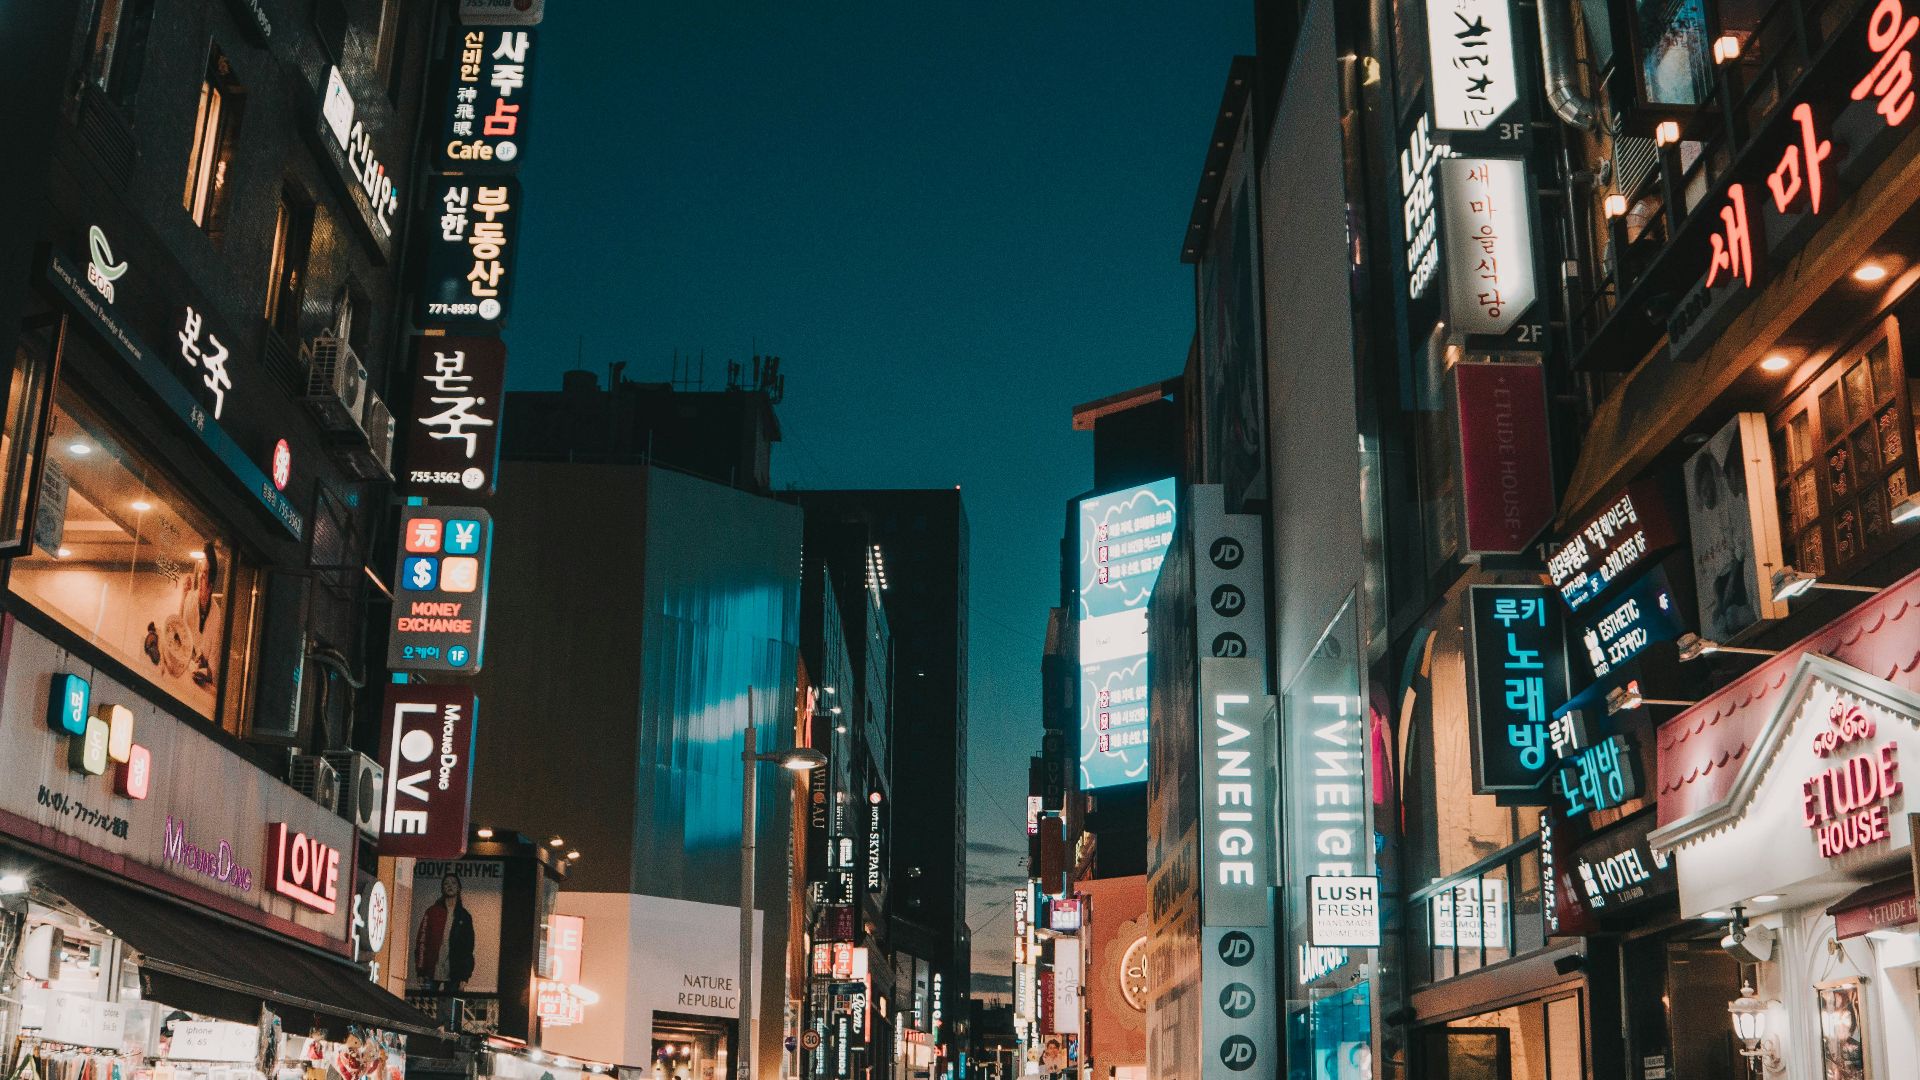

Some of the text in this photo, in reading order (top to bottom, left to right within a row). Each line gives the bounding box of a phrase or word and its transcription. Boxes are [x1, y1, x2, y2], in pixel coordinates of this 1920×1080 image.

[461, 31, 485, 82] 신비안
[1500, 123, 1524, 140] 3F
[1706, 0, 1919, 288] 새마을
[447, 140, 494, 160] Cafe
[440, 186, 469, 242] 신한
[466, 186, 510, 297] 부동산
[1467, 163, 1505, 318] 새마을식당
[428, 303, 478, 315] 771-8959
[1517, 326, 1543, 343] 2F
[179, 306, 232, 420] 본죽
[418, 351, 494, 459] 본죽
[410, 471, 460, 484] 755-3562
[415, 523, 438, 547] 元
[1214, 544, 1240, 562] JD
[1548, 535, 1590, 587] 성모부동산
[411, 602, 461, 617] MONEY
[1215, 592, 1241, 609] JD
[1494, 598, 1545, 627] 루키
[398, 618, 472, 633] EXCHANGE
[1598, 598, 1640, 641] ESTHETIC
[403, 645, 440, 660] 오케이
[451, 650, 464, 662] 1F
[1216, 640, 1243, 657] JD
[1608, 627, 1647, 664] エステサロン
[1504, 633, 1549, 770] 노래방
[1549, 711, 1578, 759] 루키
[384, 703, 438, 834] LOVE
[1560, 736, 1624, 817] 노래방
[1216, 695, 1254, 886] LANEIGE
[1802, 742, 1904, 828] ETUDE
[1818, 806, 1890, 859] HOUSE
[868, 806, 880, 888] HOTEL SKYPARK
[277, 822, 340, 916] LOVE
[1595, 847, 1651, 894] HOTEL
[1317, 886, 1373, 901] LUSH
[1318, 903, 1374, 917] FRESH
[1874, 900, 1907, 925] ETUDE
[1224, 940, 1250, 957] JD
[684, 975, 732, 990] NATURE
[679, 992, 736, 1009] REPUBLIC
[1224, 992, 1250, 1010] JD
[805, 1034, 817, 1045] 30
[1226, 1044, 1252, 1062] JD
